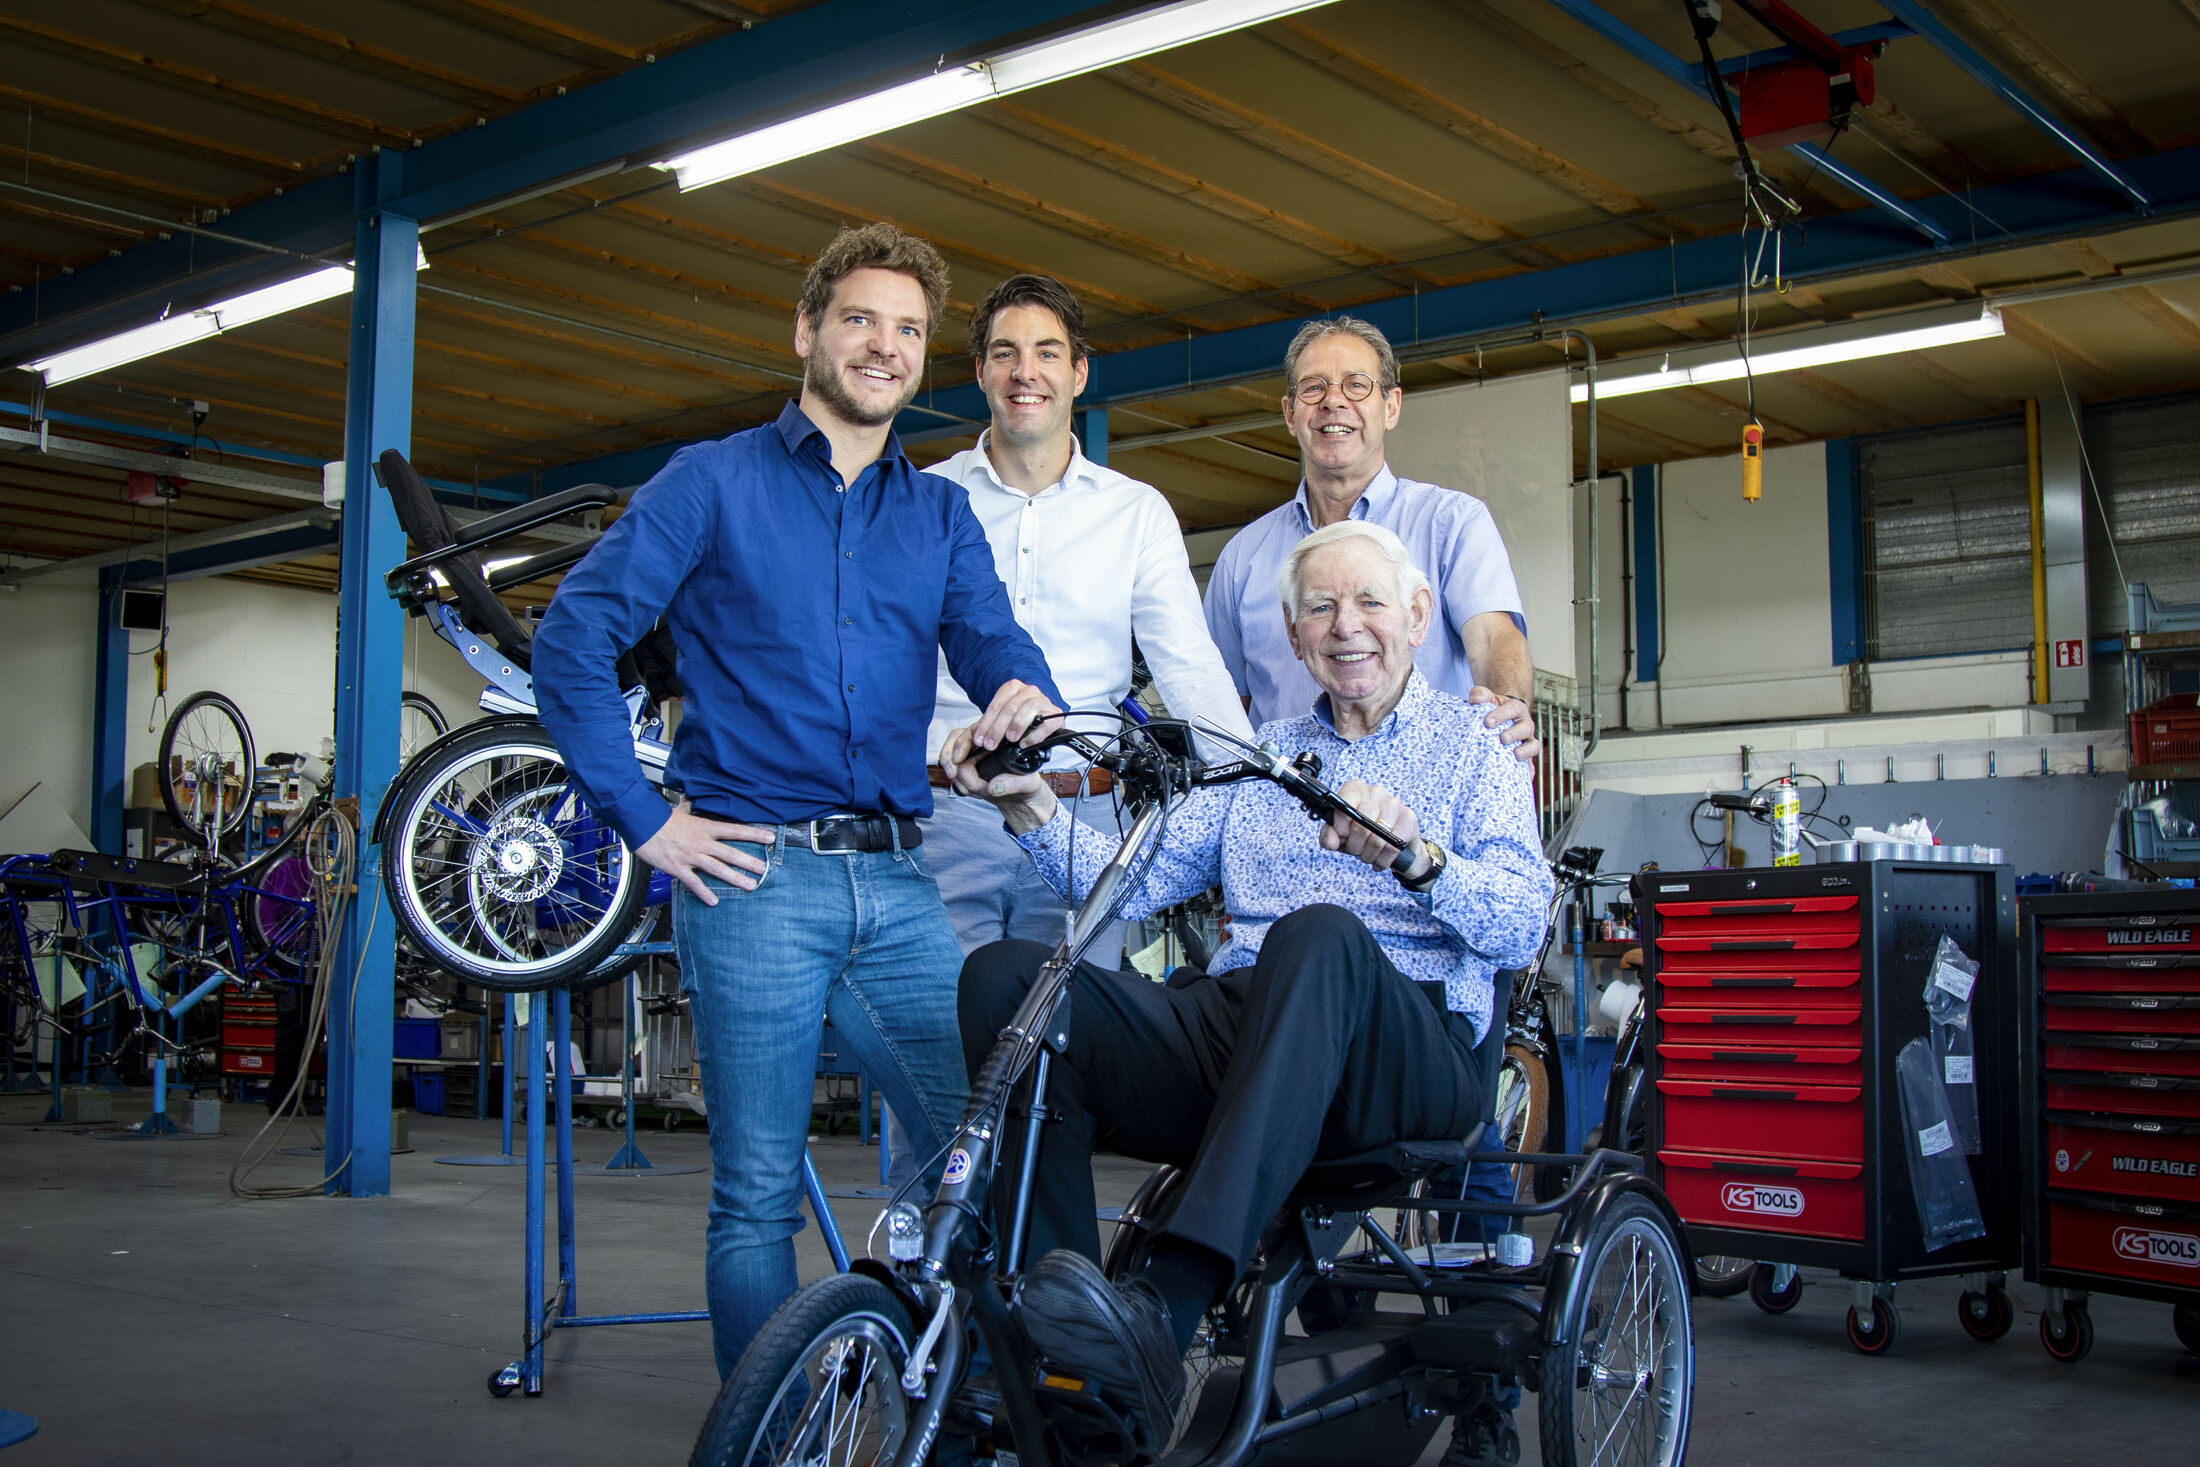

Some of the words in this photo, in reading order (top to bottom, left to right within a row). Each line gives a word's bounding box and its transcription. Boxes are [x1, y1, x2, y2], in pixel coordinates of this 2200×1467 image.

[1202, 762, 1243, 780] ZOOM
[2107, 930, 2143, 944] WILD
[2144, 929, 2192, 944] EAGLE
[2112, 1157, 2148, 1172] WILD
[2150, 1160, 2198, 1177] EAGLE
[1727, 1186, 1755, 1207] KS
[1755, 1191, 1798, 1209] TOOLS
[2119, 1232, 2149, 1254] KS
[2149, 1237, 2197, 1259] TOOLS
